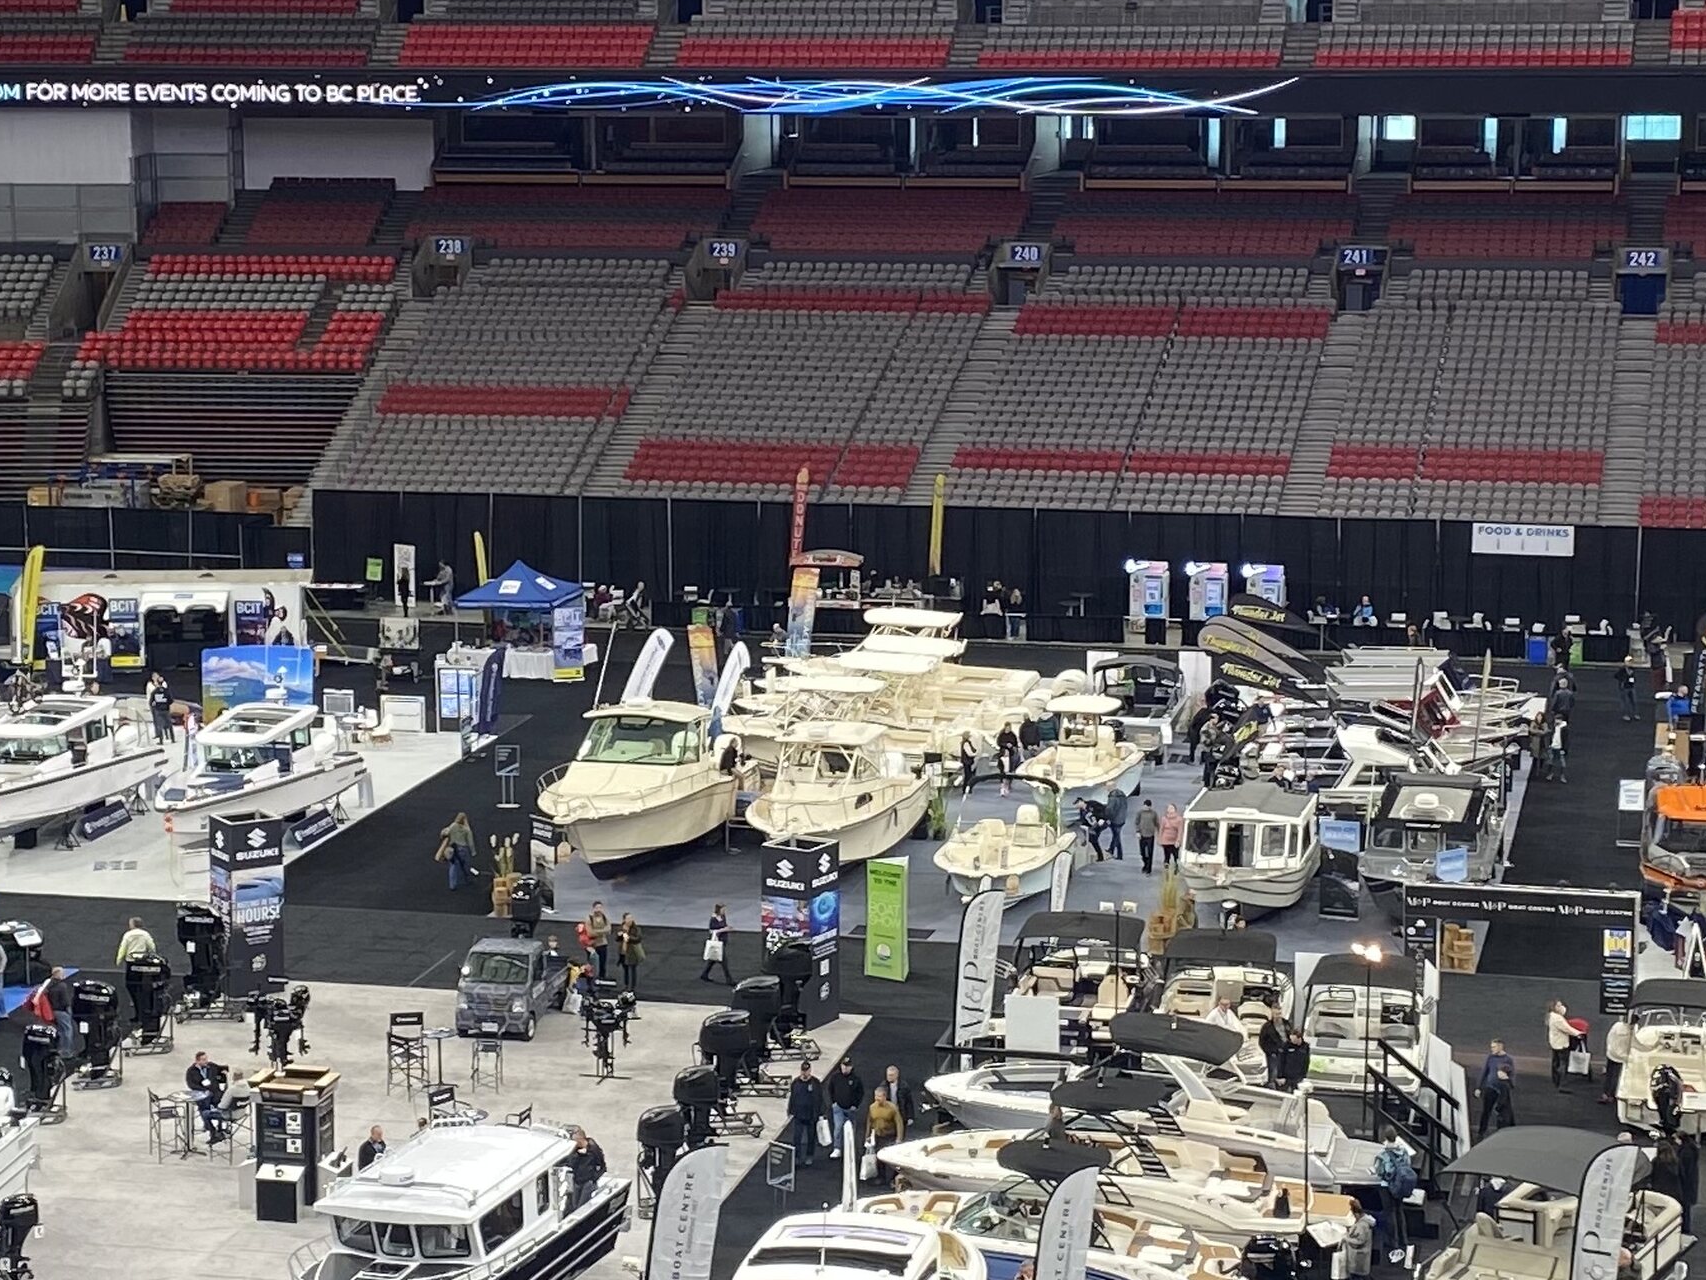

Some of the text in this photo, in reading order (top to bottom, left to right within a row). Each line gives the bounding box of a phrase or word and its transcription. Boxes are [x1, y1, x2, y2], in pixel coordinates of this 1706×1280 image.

[25, 82, 67, 101] FOR
[71, 82, 131, 101] MORE
[135, 83, 207, 102] EVENTS
[210, 83, 290, 102] COMING
[293, 84, 322, 102] TO
[325, 84, 353, 102] BC
[93, 246, 116, 260] 237
[438, 239, 462, 254] 238
[712, 243, 736, 257] 239
[1014, 246, 1039, 261] 240
[1343, 249, 1368, 264] 241
[1629, 251, 1656, 266] 242
[1478, 526, 1570, 538] FOOD & DRINKS
[109, 600, 136, 613] BCIT
[236, 602, 262, 614] BCIT
[236, 846, 280, 860] SUZUKI
[765, 877, 806, 891] SUZUKI
[237, 904, 282, 923] HOURS!
[670, 1171, 695, 1280] BOAT CENTRE
[1057, 1198, 1071, 1262] CENTRE
